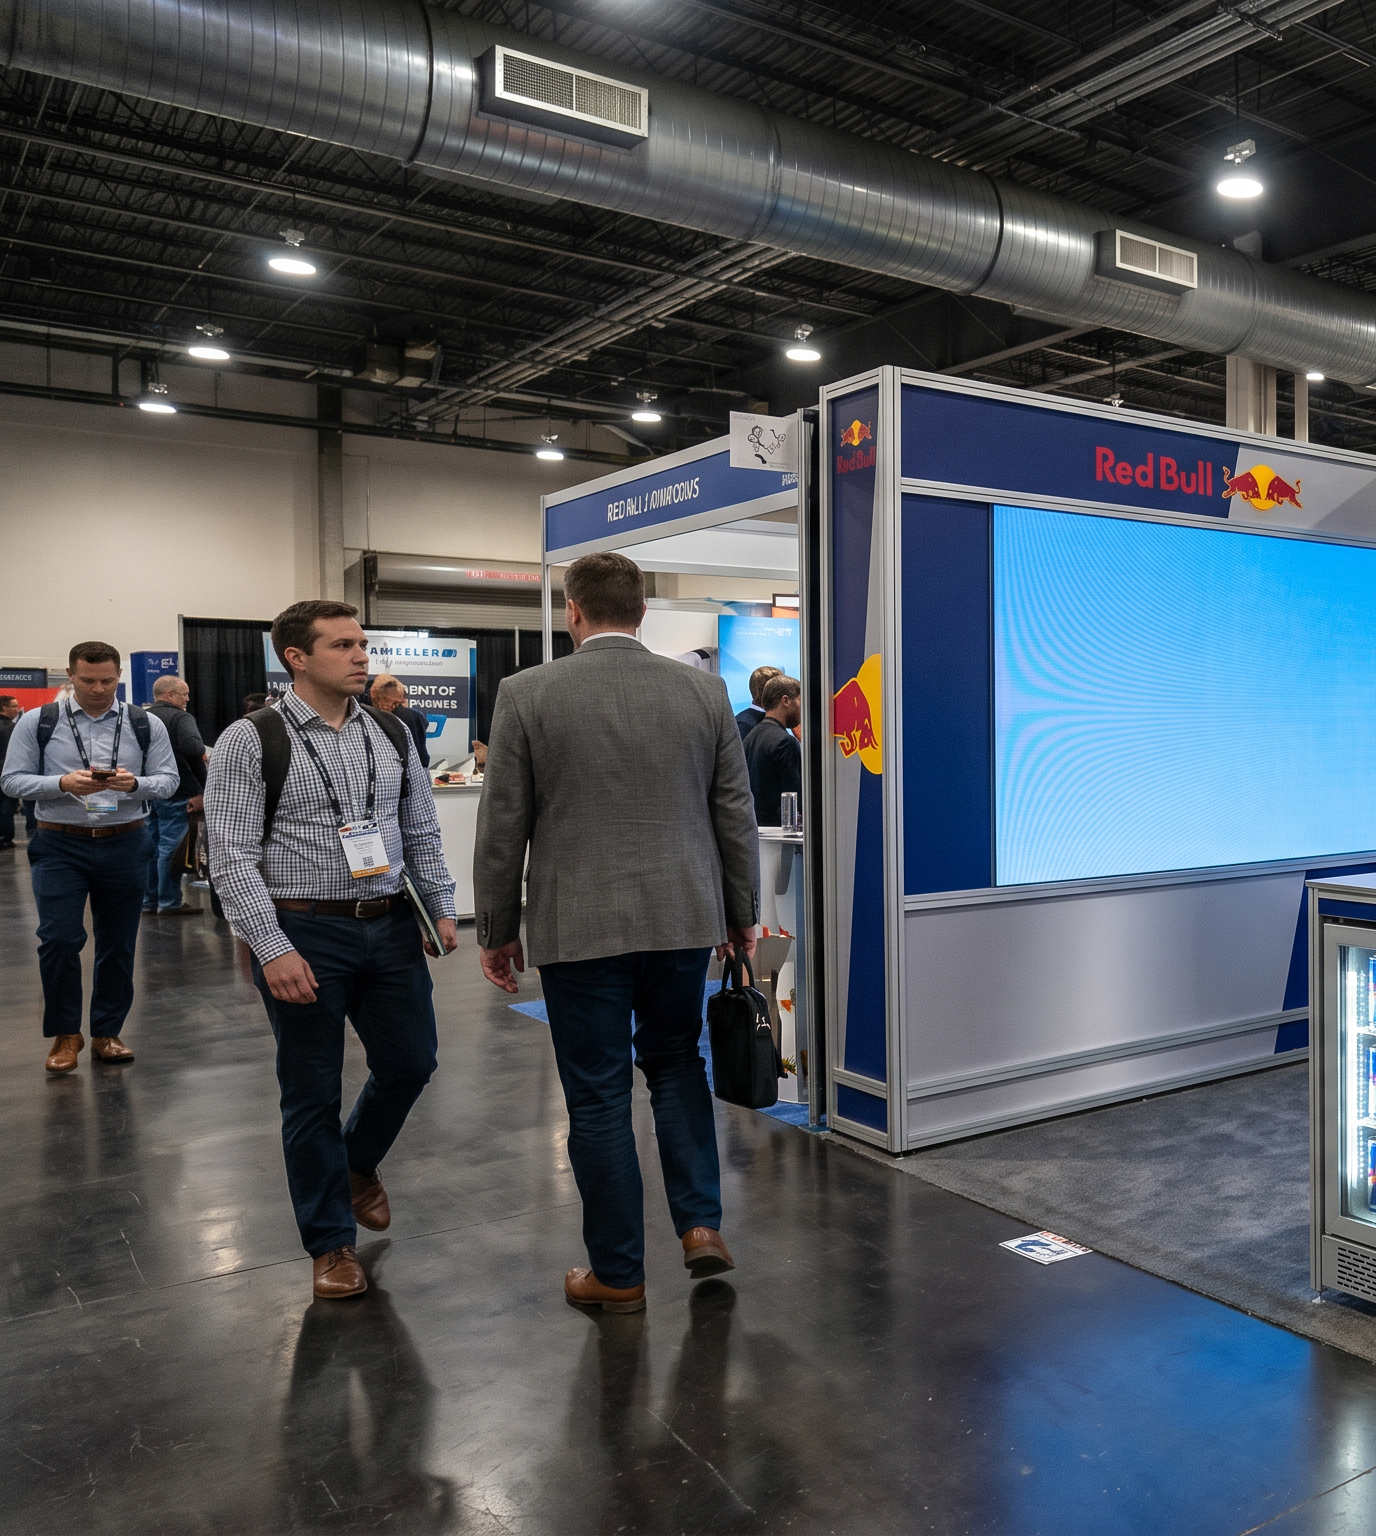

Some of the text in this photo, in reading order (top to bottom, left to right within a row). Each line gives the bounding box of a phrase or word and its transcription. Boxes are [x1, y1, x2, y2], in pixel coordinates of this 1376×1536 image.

[1095, 446, 1213, 496] Red Bull
[607, 500, 626, 523] RED
